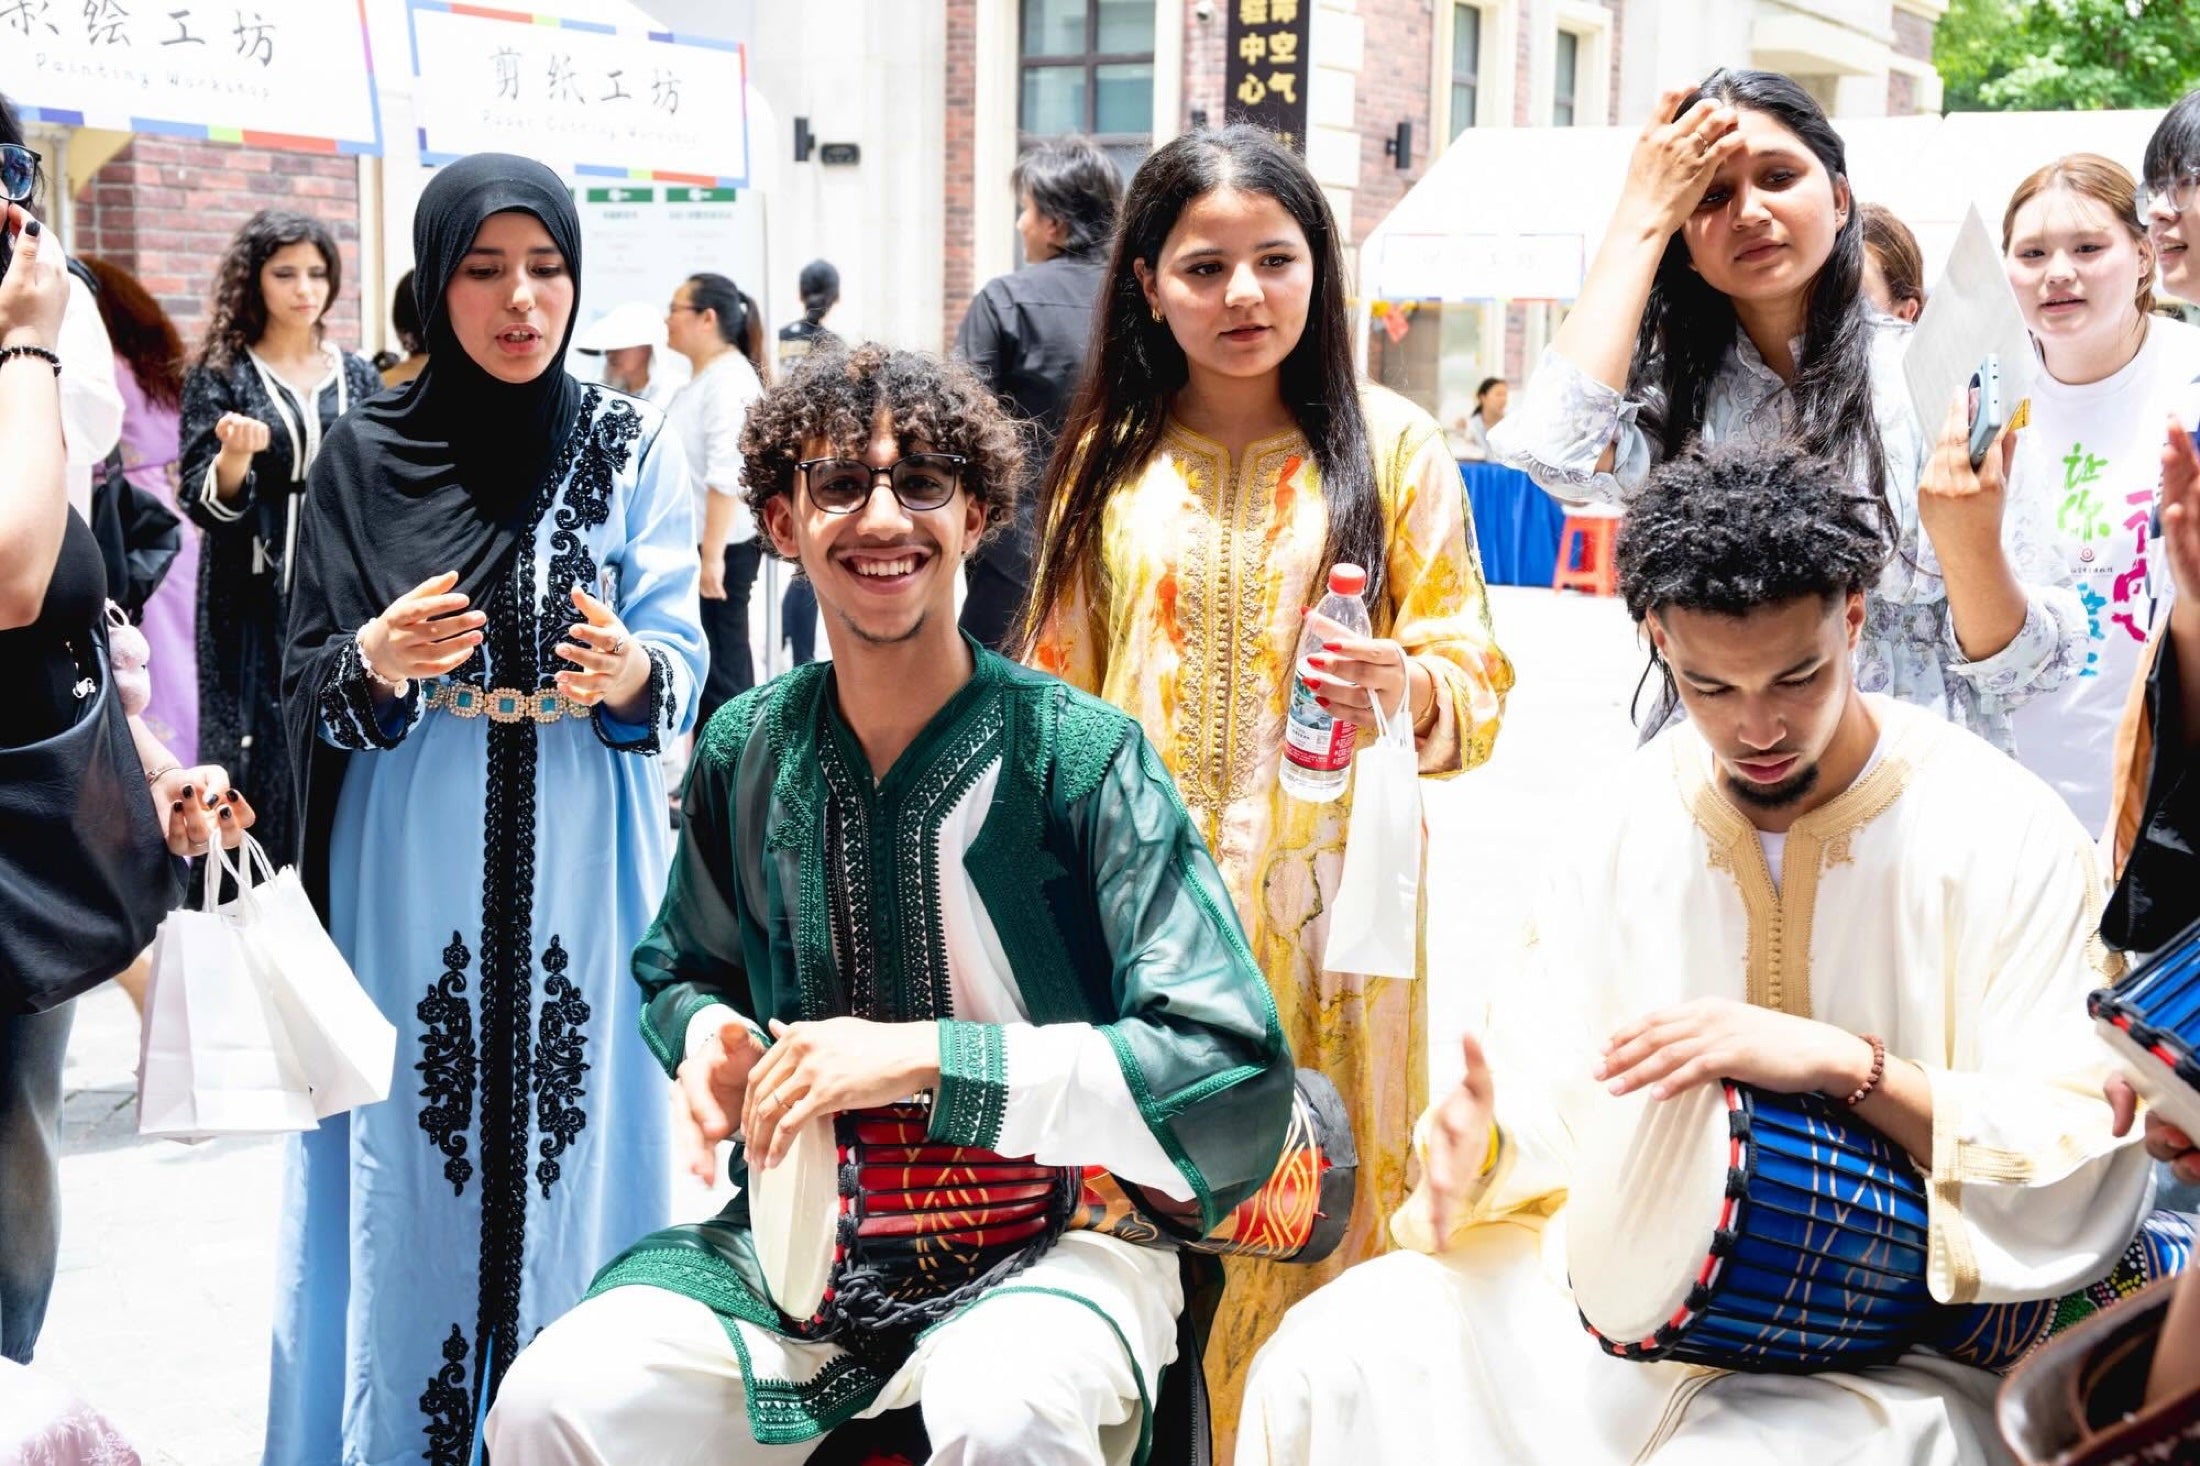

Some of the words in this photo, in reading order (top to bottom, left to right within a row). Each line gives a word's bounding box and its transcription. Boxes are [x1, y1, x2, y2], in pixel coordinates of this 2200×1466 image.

[36, 52, 149, 89] Painting
[489, 46, 682, 115] 剪纸工坊
